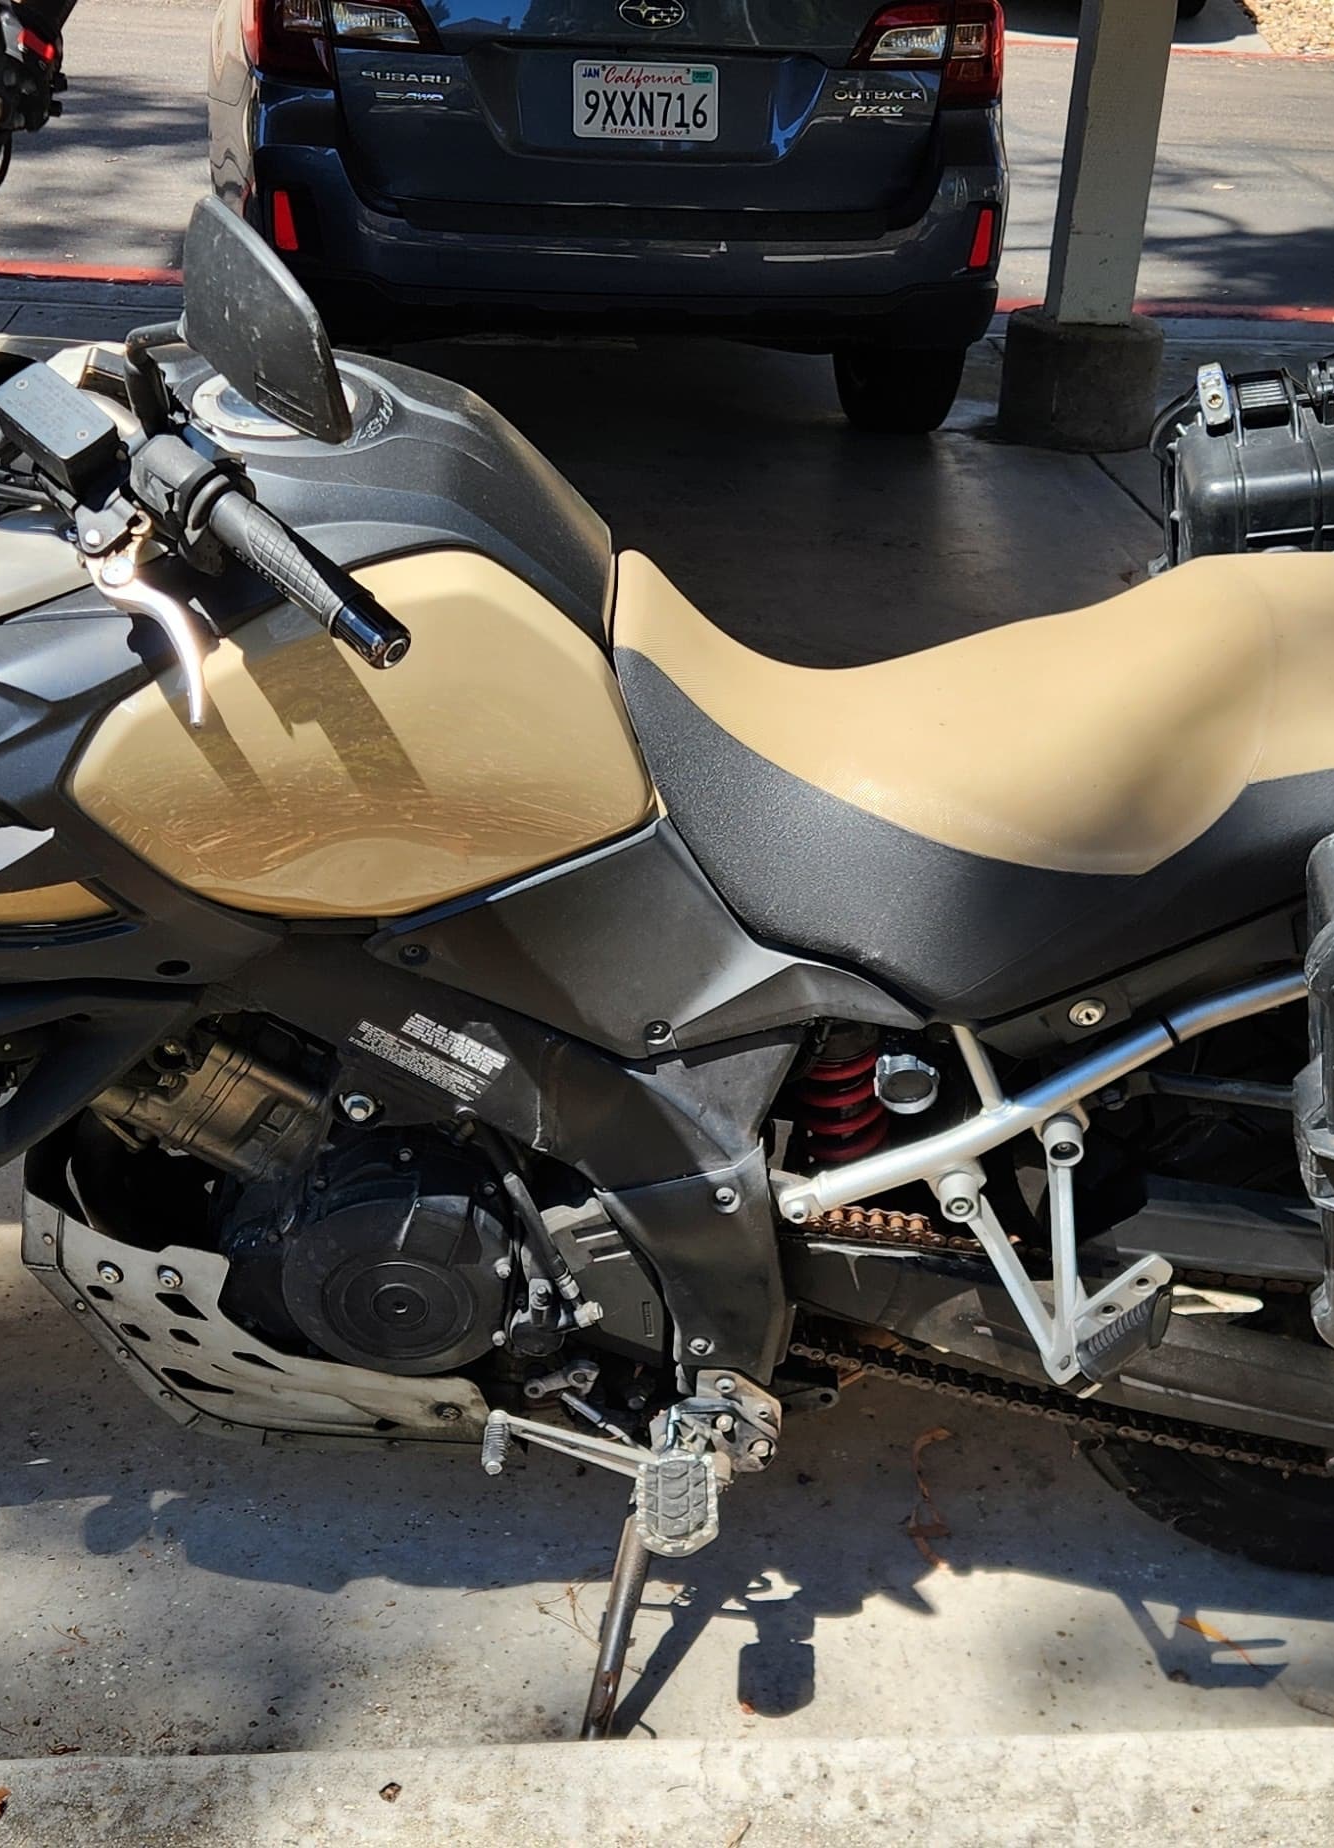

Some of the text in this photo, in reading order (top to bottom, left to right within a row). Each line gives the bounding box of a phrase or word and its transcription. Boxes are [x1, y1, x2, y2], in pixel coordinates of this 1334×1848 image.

[361, 71, 451, 84] SUBARU
[582, 66, 600, 79] JAN
[604, 65, 692, 89] California
[834, 89, 923, 100] OUTBACK
[583, 89, 708, 129] 9XXN716
[610, 127, 683, 137] dmv.ca.gov
